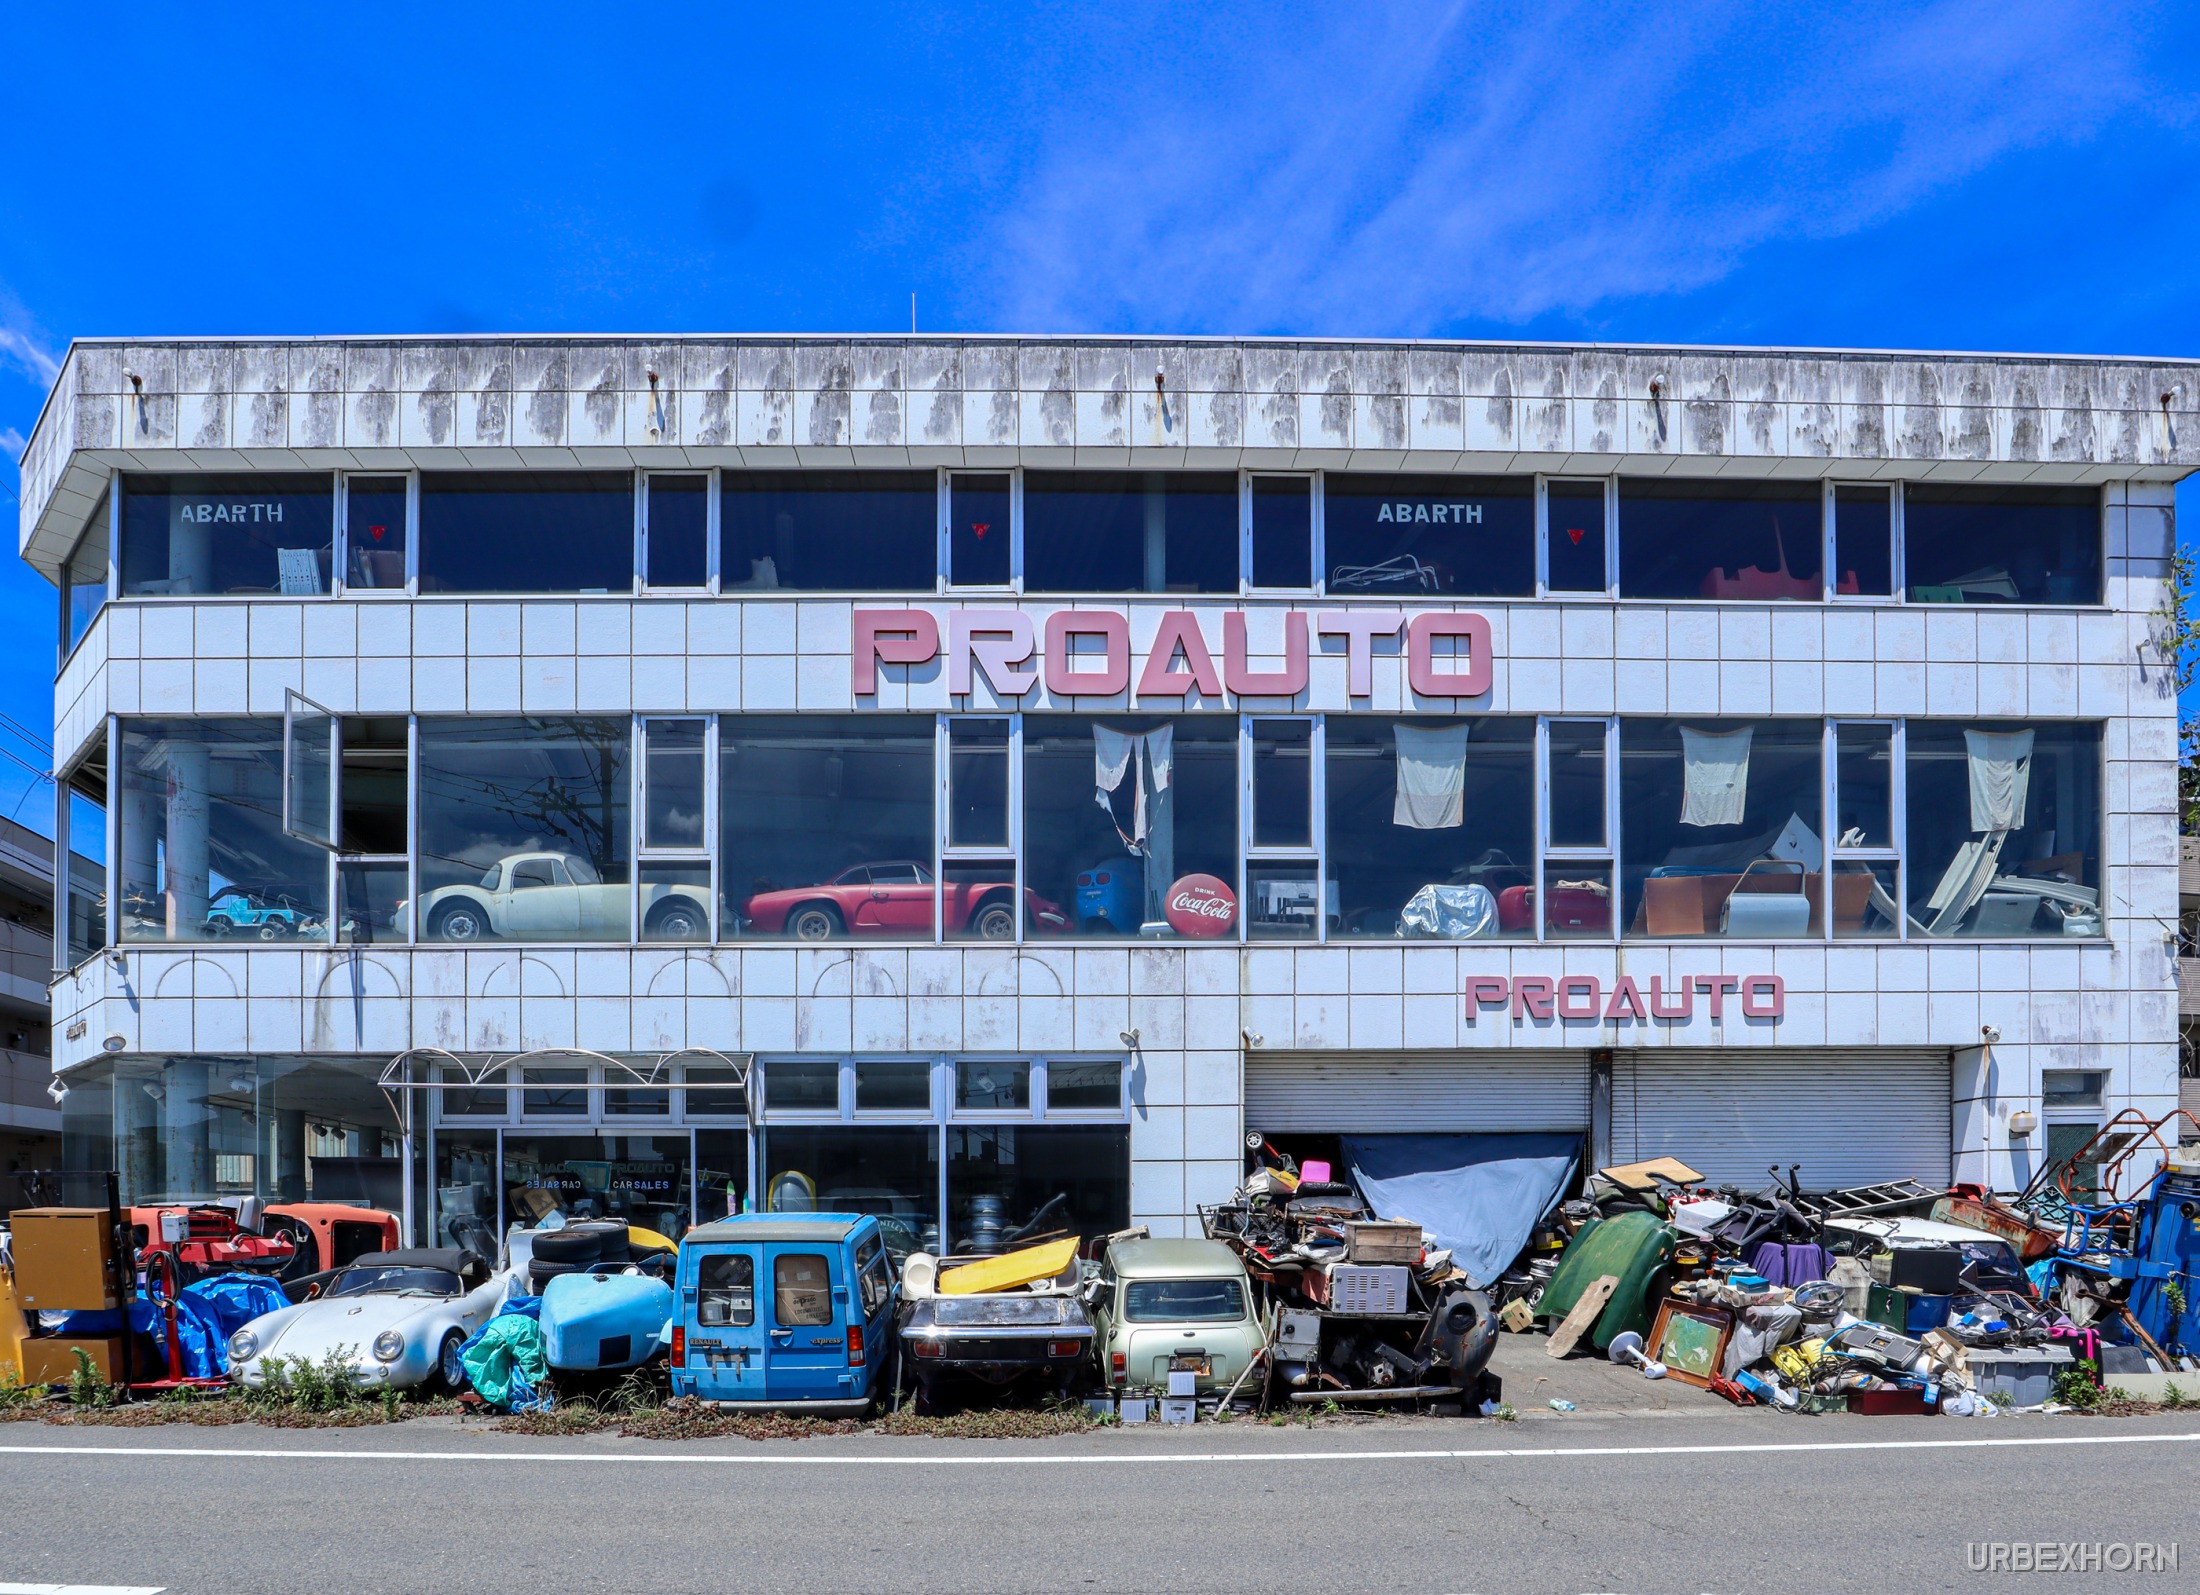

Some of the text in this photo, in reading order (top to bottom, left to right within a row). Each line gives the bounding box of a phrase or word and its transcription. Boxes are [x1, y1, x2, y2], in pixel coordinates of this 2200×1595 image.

[180, 503, 283, 523] ABARTH
[1377, 502, 1483, 524] ABARTH
[853, 608, 1493, 697] PROAUTO
[1194, 887, 1216, 896] DRINK
[1465, 975, 1784, 1019] PROAUTO
[613, 1181, 669, 1190] CAR SALES
